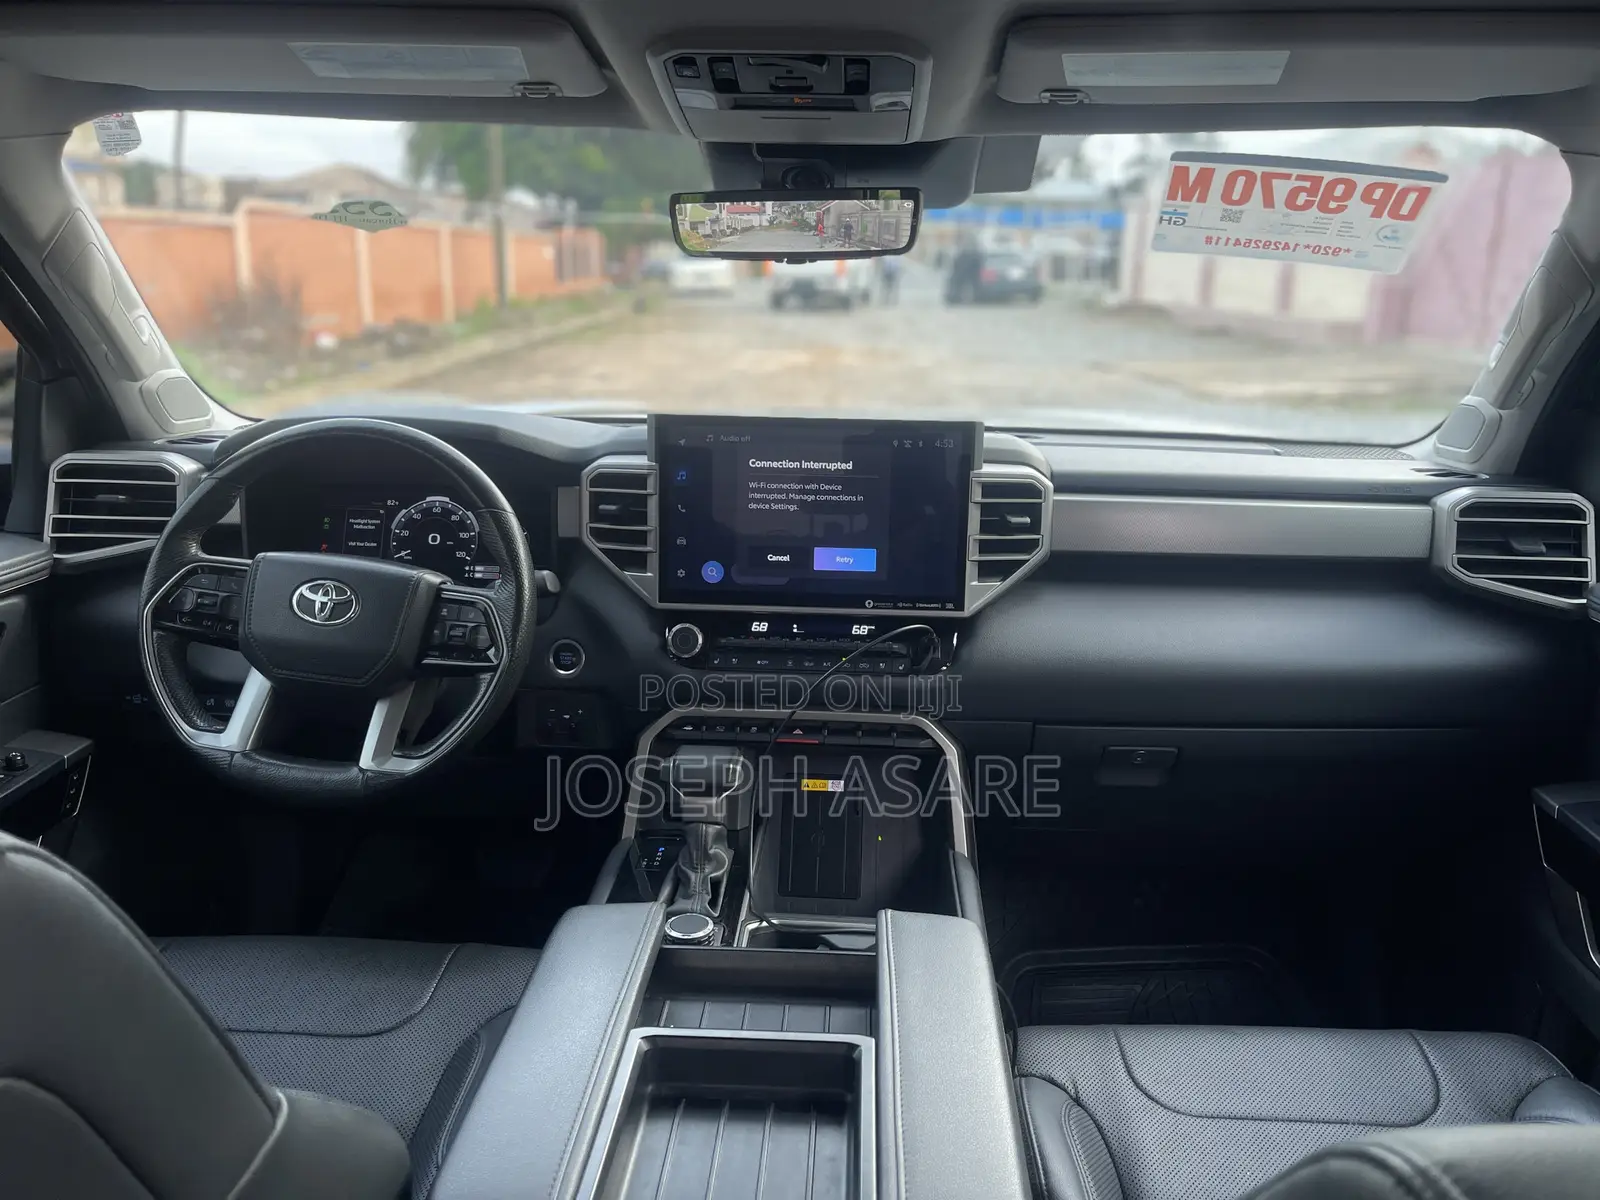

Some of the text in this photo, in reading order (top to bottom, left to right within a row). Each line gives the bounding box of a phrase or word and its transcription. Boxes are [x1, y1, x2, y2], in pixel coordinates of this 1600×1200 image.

[719, 434, 751, 443] Audio off
[934, 438, 954, 449] 4:53
[748, 458, 853, 471] Connection Interrupted
[748, 481, 766, 489] Wi-Fi
[766, 482, 804, 490] connection
[819, 483, 843, 491] Device
[748, 491, 864, 502] interrupted. Manage connections in
[748, 502, 800, 512] device Settings.
[412, 512, 422, 520] 40
[400, 529, 410, 537] 20
[767, 554, 854, 564] Cancel Retry
[752, 622, 768, 632] 68
